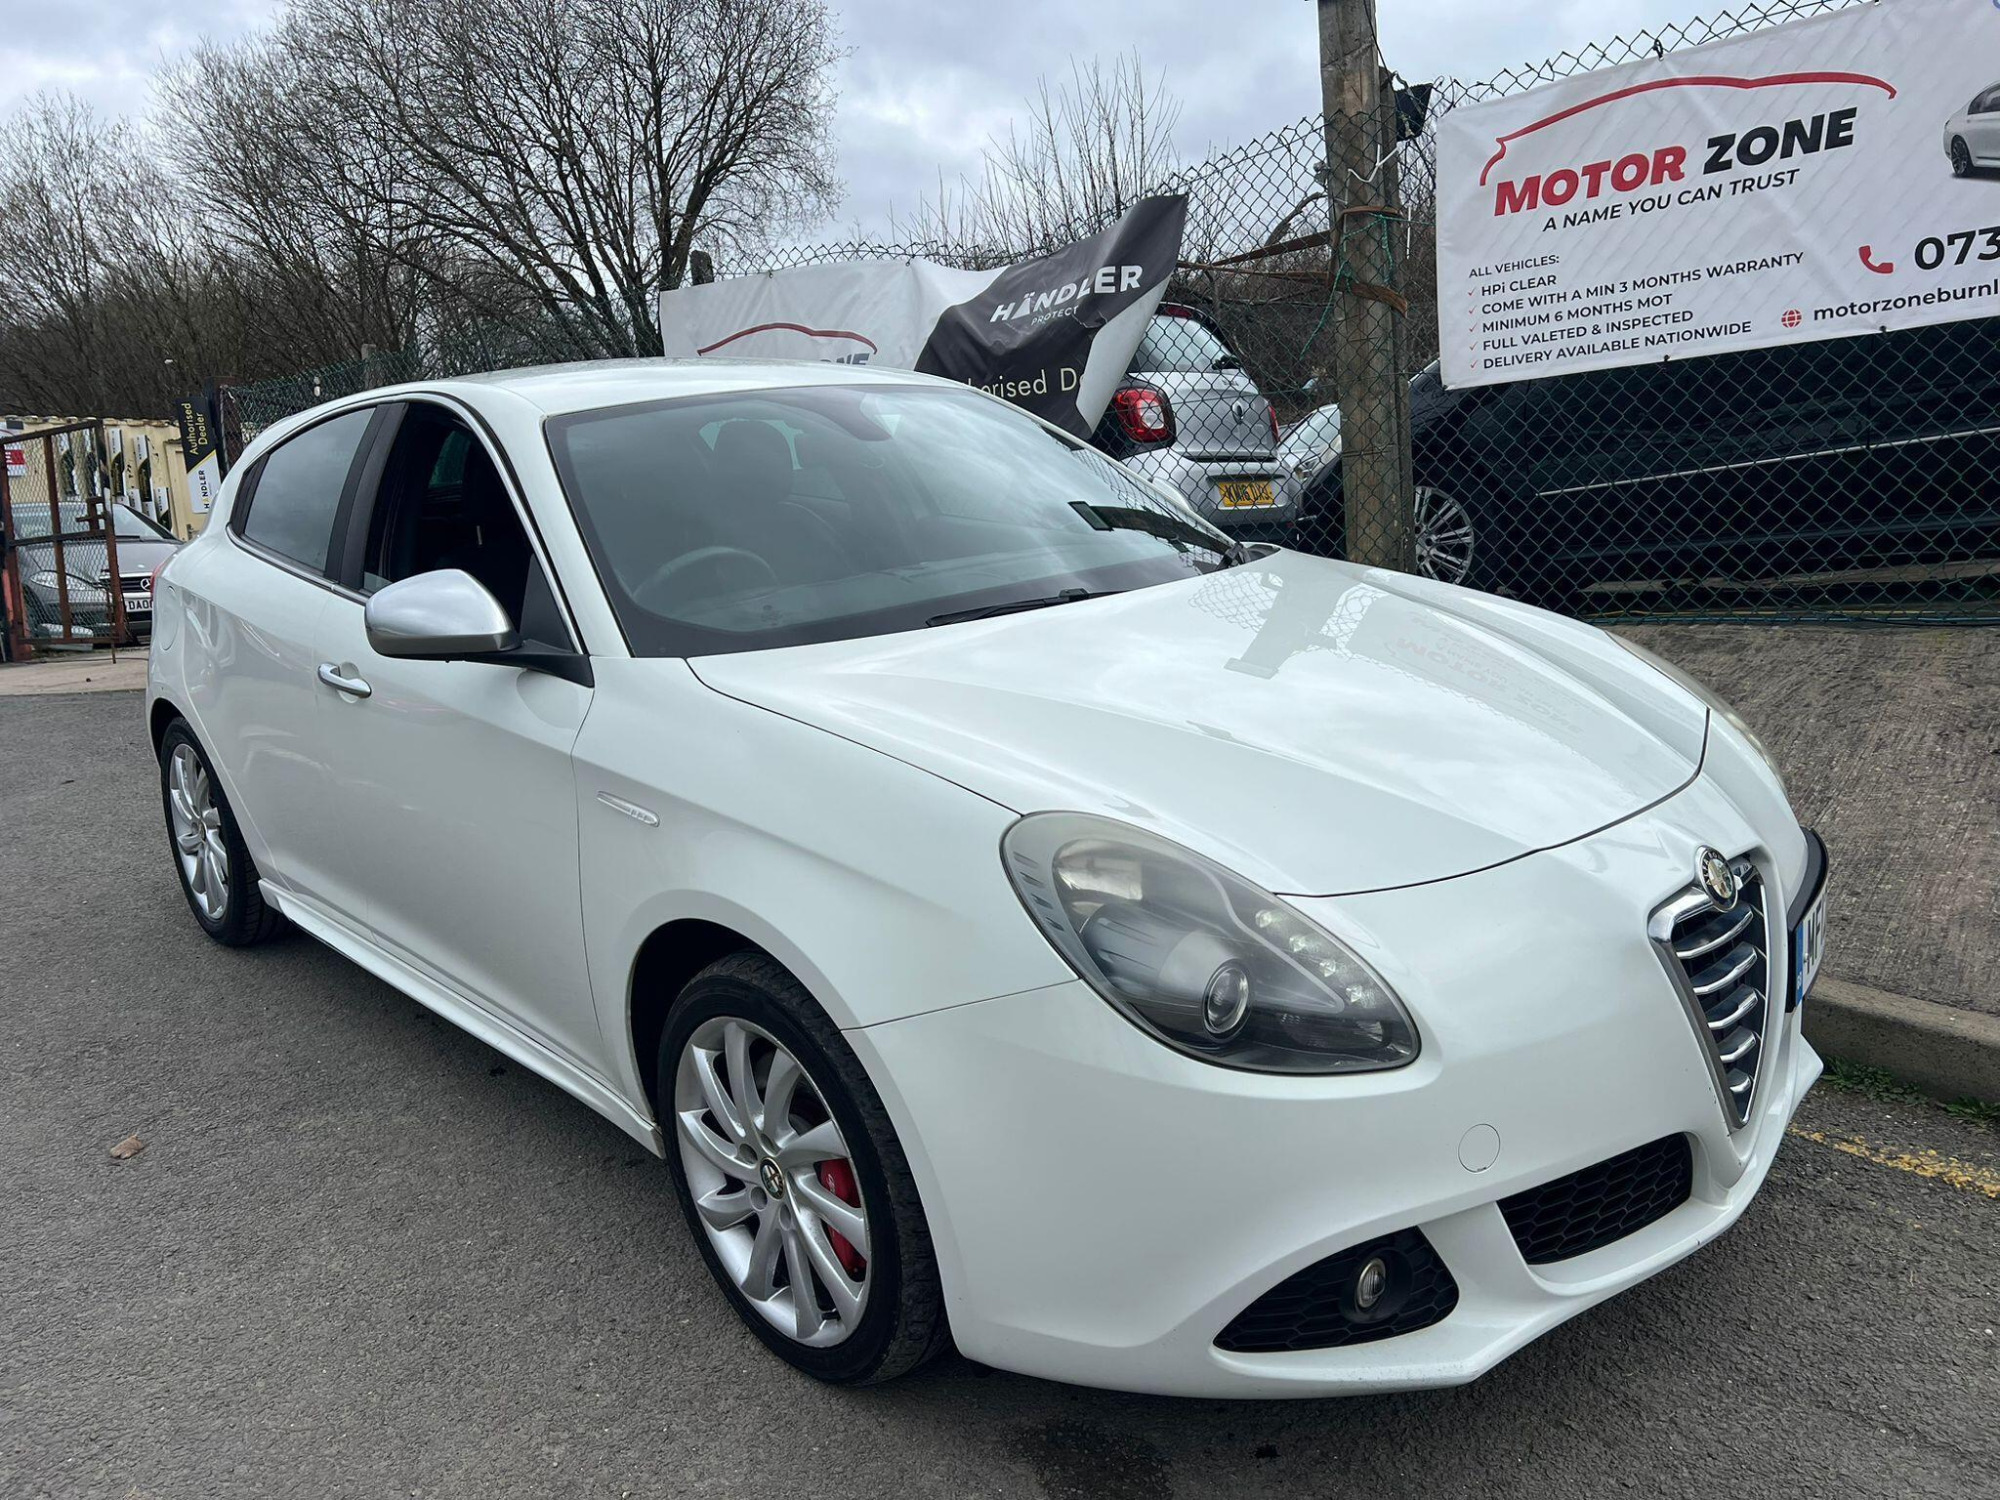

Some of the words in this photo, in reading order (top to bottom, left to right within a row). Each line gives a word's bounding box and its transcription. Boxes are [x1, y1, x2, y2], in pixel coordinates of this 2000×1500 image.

[1494, 146, 1687, 217] MOTOR
[1703, 107, 1857, 175] ZONE
[1543, 217, 1557, 232] A
[1563, 203, 1622, 228] NAME
[1628, 193, 1671, 216] YOU
[1677, 183, 1723, 206] CAN
[1729, 168, 1800, 196] TRUST
[1469, 266, 1492, 278] ALL
[1495, 254, 1560, 274] VEHICLES:
[1481, 281, 1506, 297] HPi
[1509, 274, 1557, 292] CLEAR
[1482, 298, 1524, 315] COME
[1528, 291, 1567, 308] WITH
[1571, 289, 1582, 301] A
[1586, 283, 1615, 299] MIN
[1619, 281, 1628, 293] 3
[1632, 269, 1702, 291] MONTHS
[1706, 251, 1804, 278] WARRANTY
[1031, 304, 1079, 326] PROTECT
[1482, 312, 1550, 333] MINIMUM
[1554, 310, 1563, 322] 6
[1567, 300, 1633, 320] MONTHS
[1637, 293, 1673, 310] MOT
[1813, 278, 1999, 321] motorzoneburnl
[1483, 336, 1518, 351] FULL
[1521, 326, 1587, 345] VALETED
[1591, 323, 1602, 335] &
[1606, 310, 1694, 333] INSPECTED
[1483, 350, 1553, 369] DELIVERY
[1556, 337, 1640, 359] AVAILABLE
[1644, 320, 1752, 347] NATIONWIDE
[181, 402, 199, 456] Authorised
[196, 412, 209, 446] Dealer
